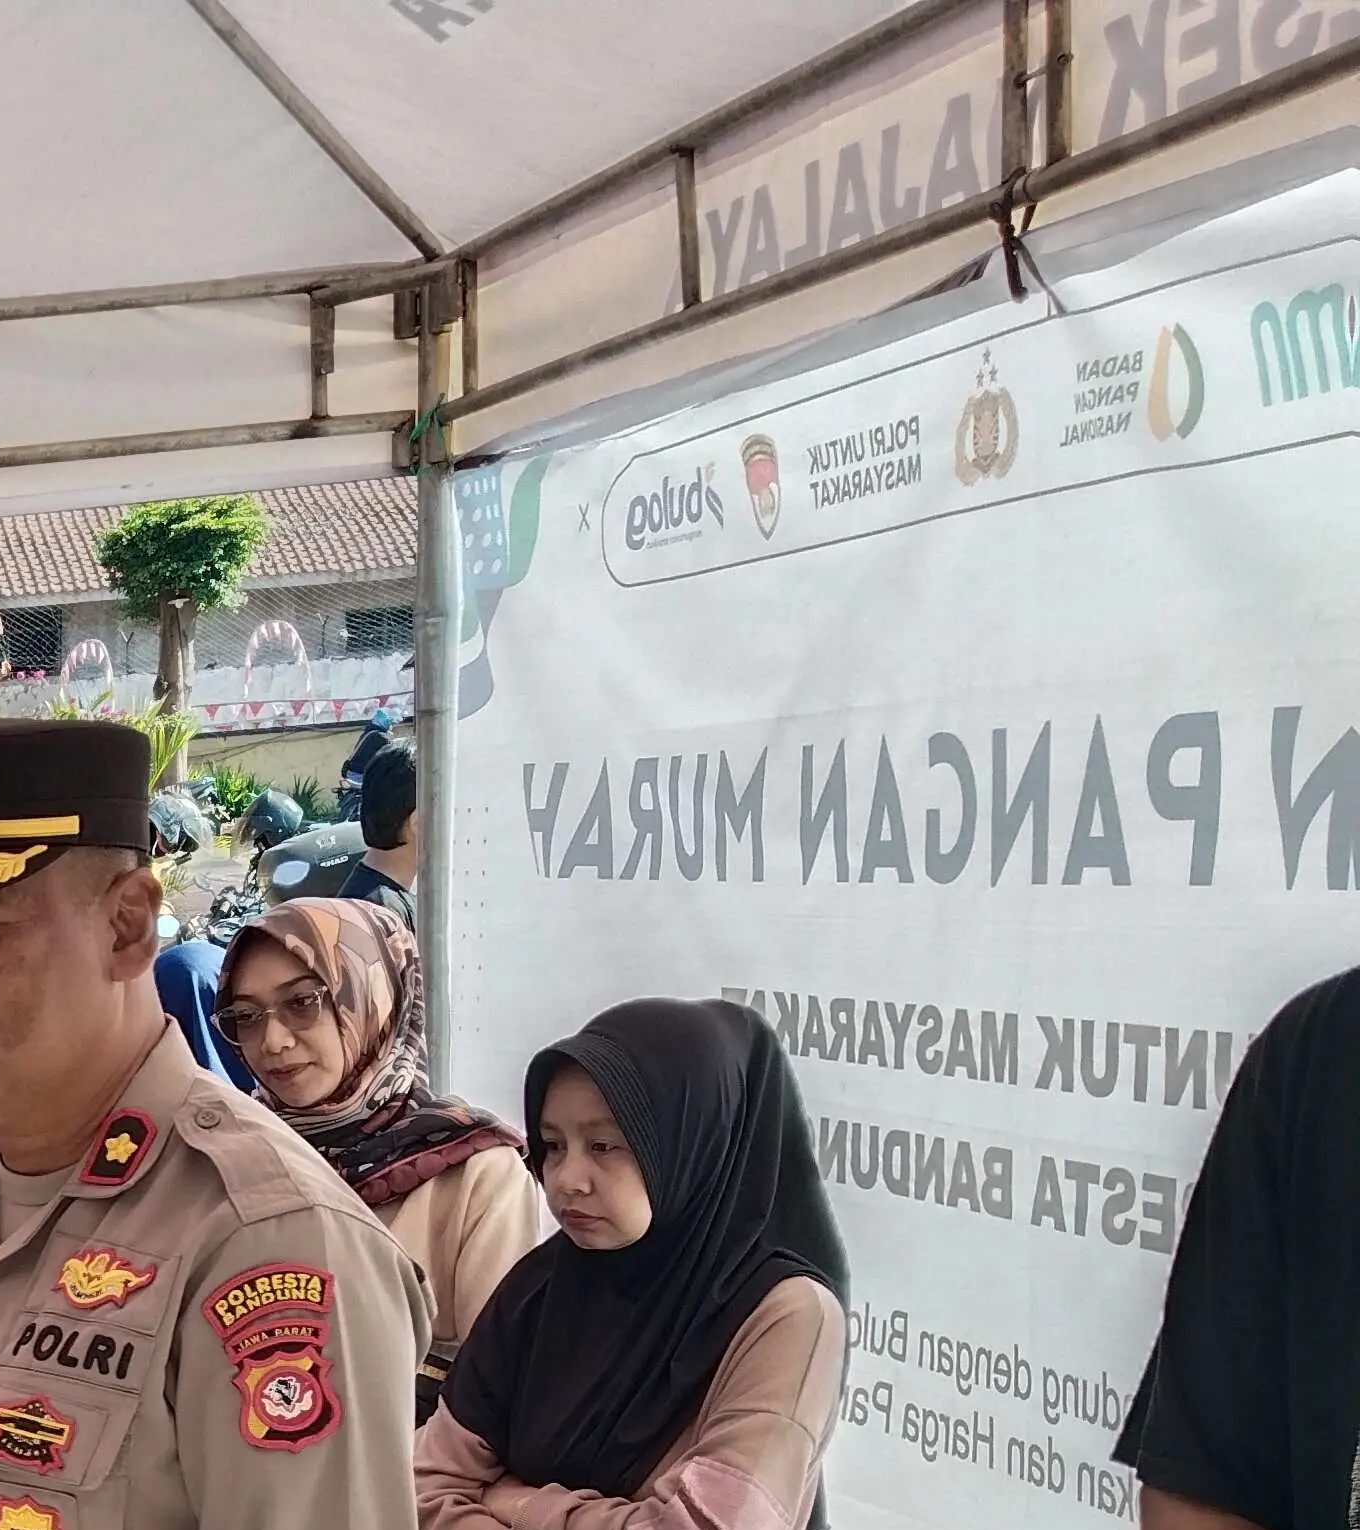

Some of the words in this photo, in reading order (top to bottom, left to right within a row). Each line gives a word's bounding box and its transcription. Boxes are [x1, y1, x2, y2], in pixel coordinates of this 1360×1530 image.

[215, 1272, 322, 1318] POLRESTA
[222, 1287, 321, 1326] BANDUNG
[12, 1322, 135, 1380] POLRI
[237, 1331, 269, 1353] JAWA
